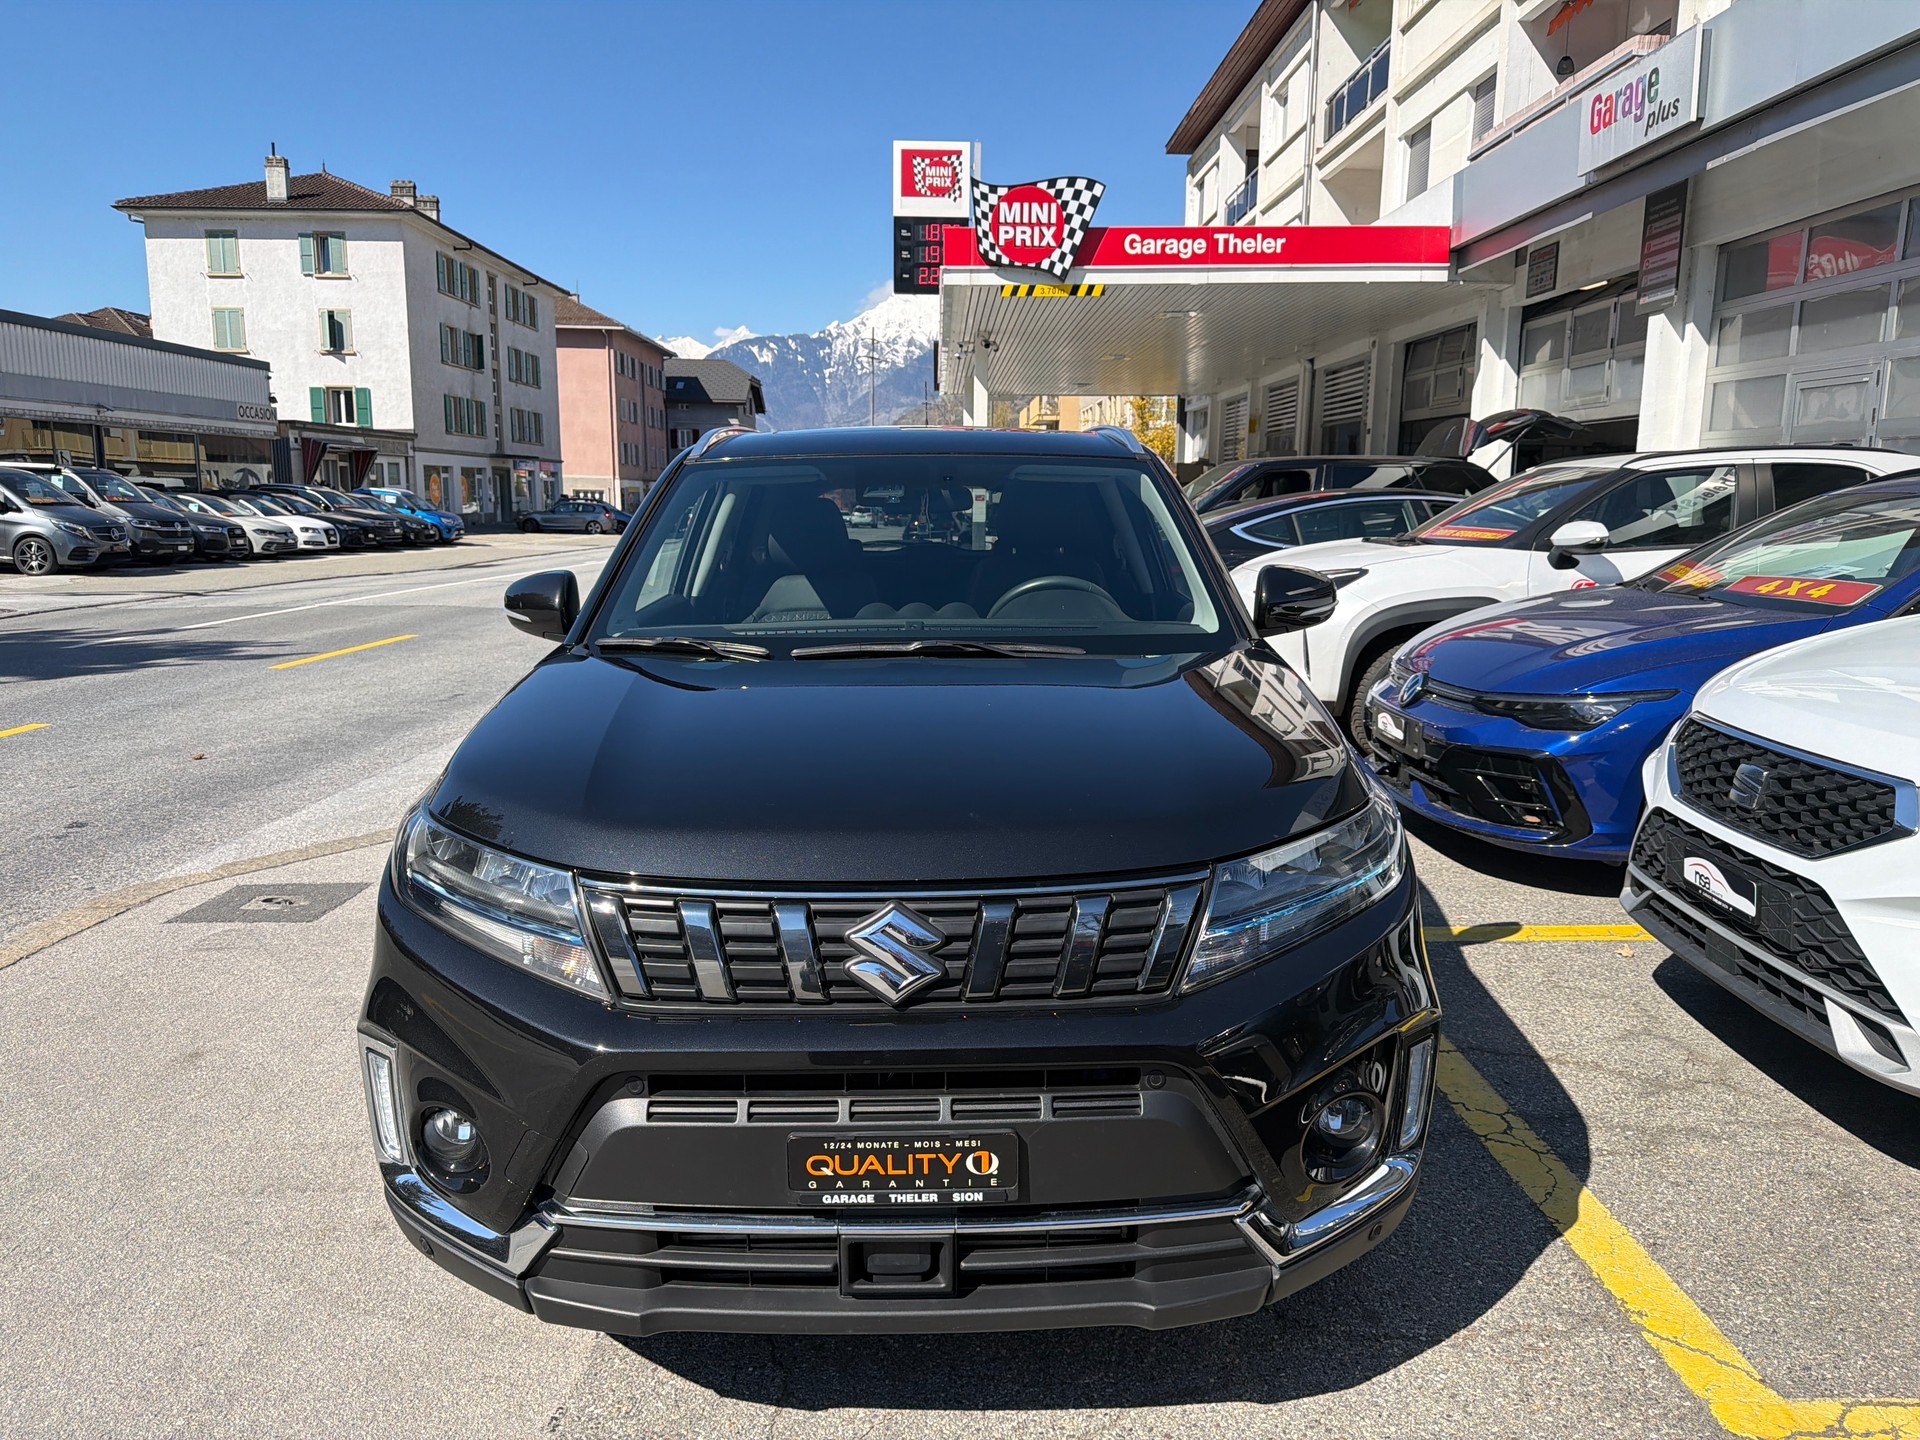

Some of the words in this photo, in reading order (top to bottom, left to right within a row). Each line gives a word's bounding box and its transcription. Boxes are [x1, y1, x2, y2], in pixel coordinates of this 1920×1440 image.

[1590, 67, 1660, 135] Garage
[1644, 97, 1680, 137] plus
[925, 166, 952, 177] MINI
[925, 177, 952, 188] PRIX
[998, 201, 1058, 225] MINI
[998, 225, 1058, 248] PRIX
[1123, 233, 1207, 259] Garage
[1213, 232, 1287, 254] Theler
[1755, 579, 1837, 599] 4X4
[1694, 869, 1711, 891] nsa
[823, 1142, 852, 1150] 12/24
[857, 1141, 900, 1149] MONATE
[914, 1140, 941, 1148] MOIS
[955, 1139, 981, 1147] MESI
[806, 1152, 962, 1176] QUALITY
[822, 1194, 875, 1204] GARAGE
[889, 1193, 938, 1203] THELER
[952, 1192, 983, 1202] SION
